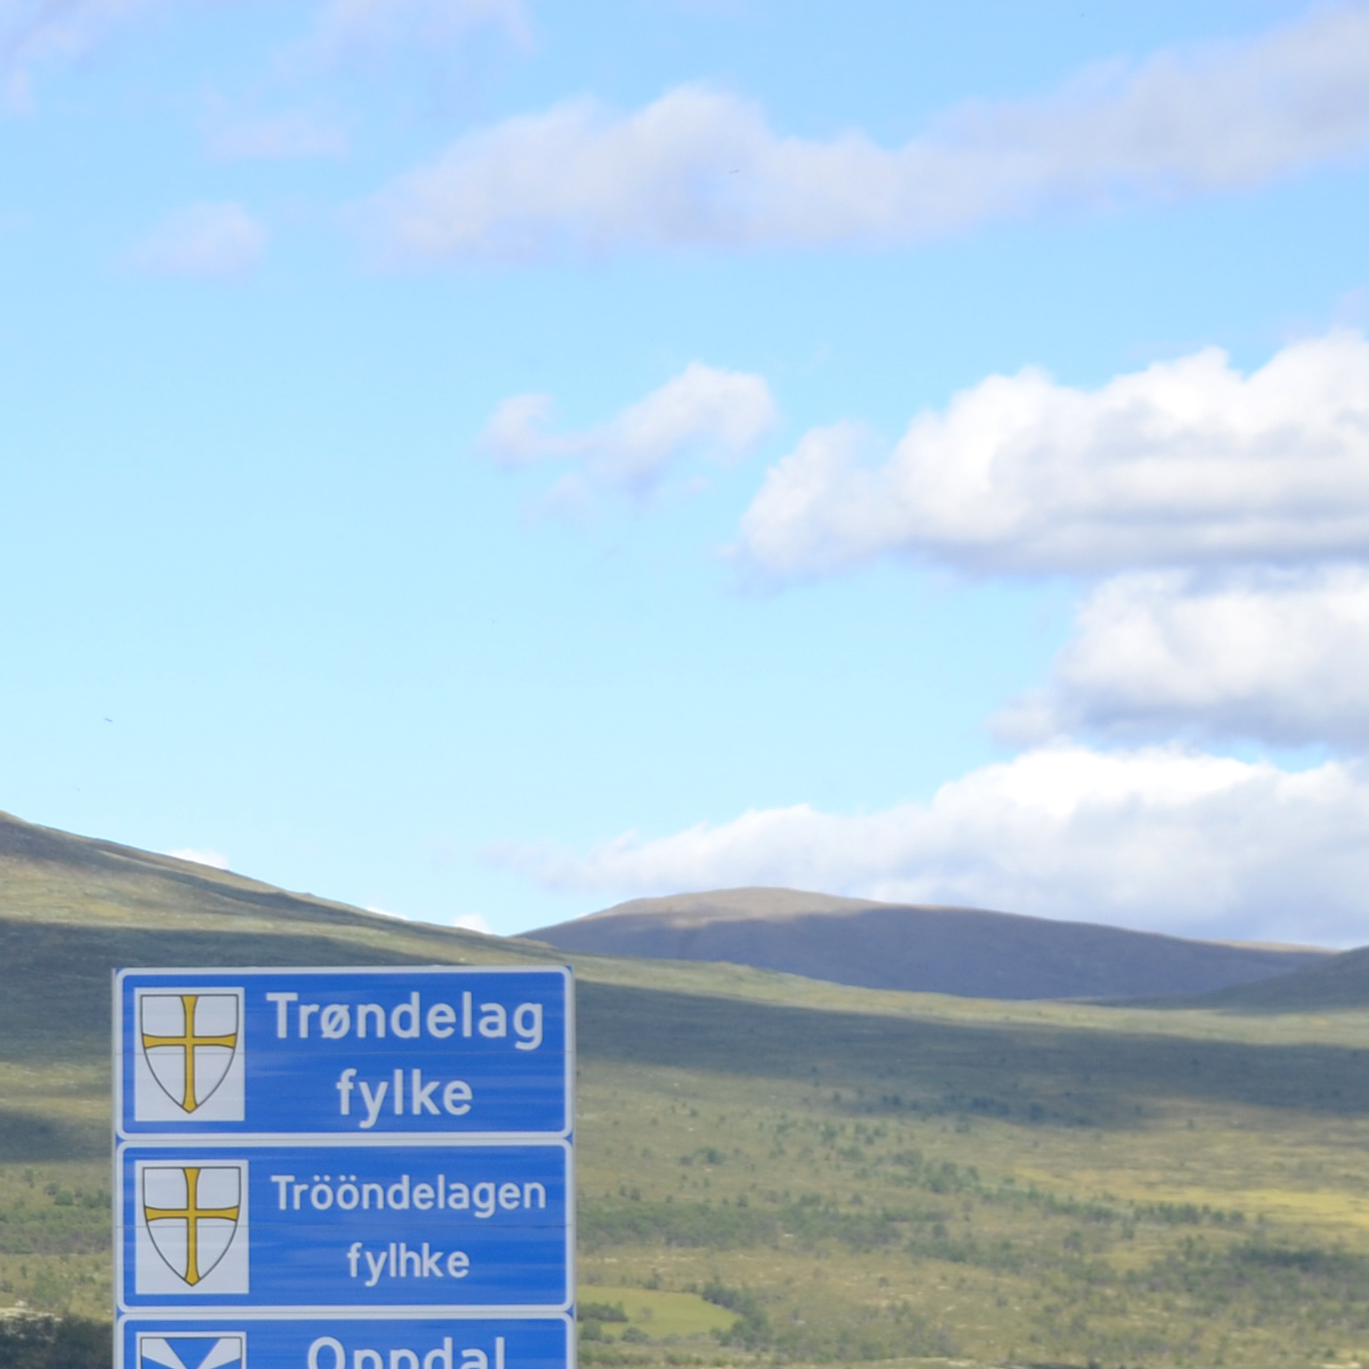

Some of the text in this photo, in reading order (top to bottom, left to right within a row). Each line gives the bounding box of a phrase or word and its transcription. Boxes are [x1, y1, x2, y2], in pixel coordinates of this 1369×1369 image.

[266, 991, 543, 1050] Trøndelag
[336, 1068, 473, 1128] fylke
[270, 1174, 546, 1218] Trööndelagen
[347, 1242, 470, 1287] fylhke
